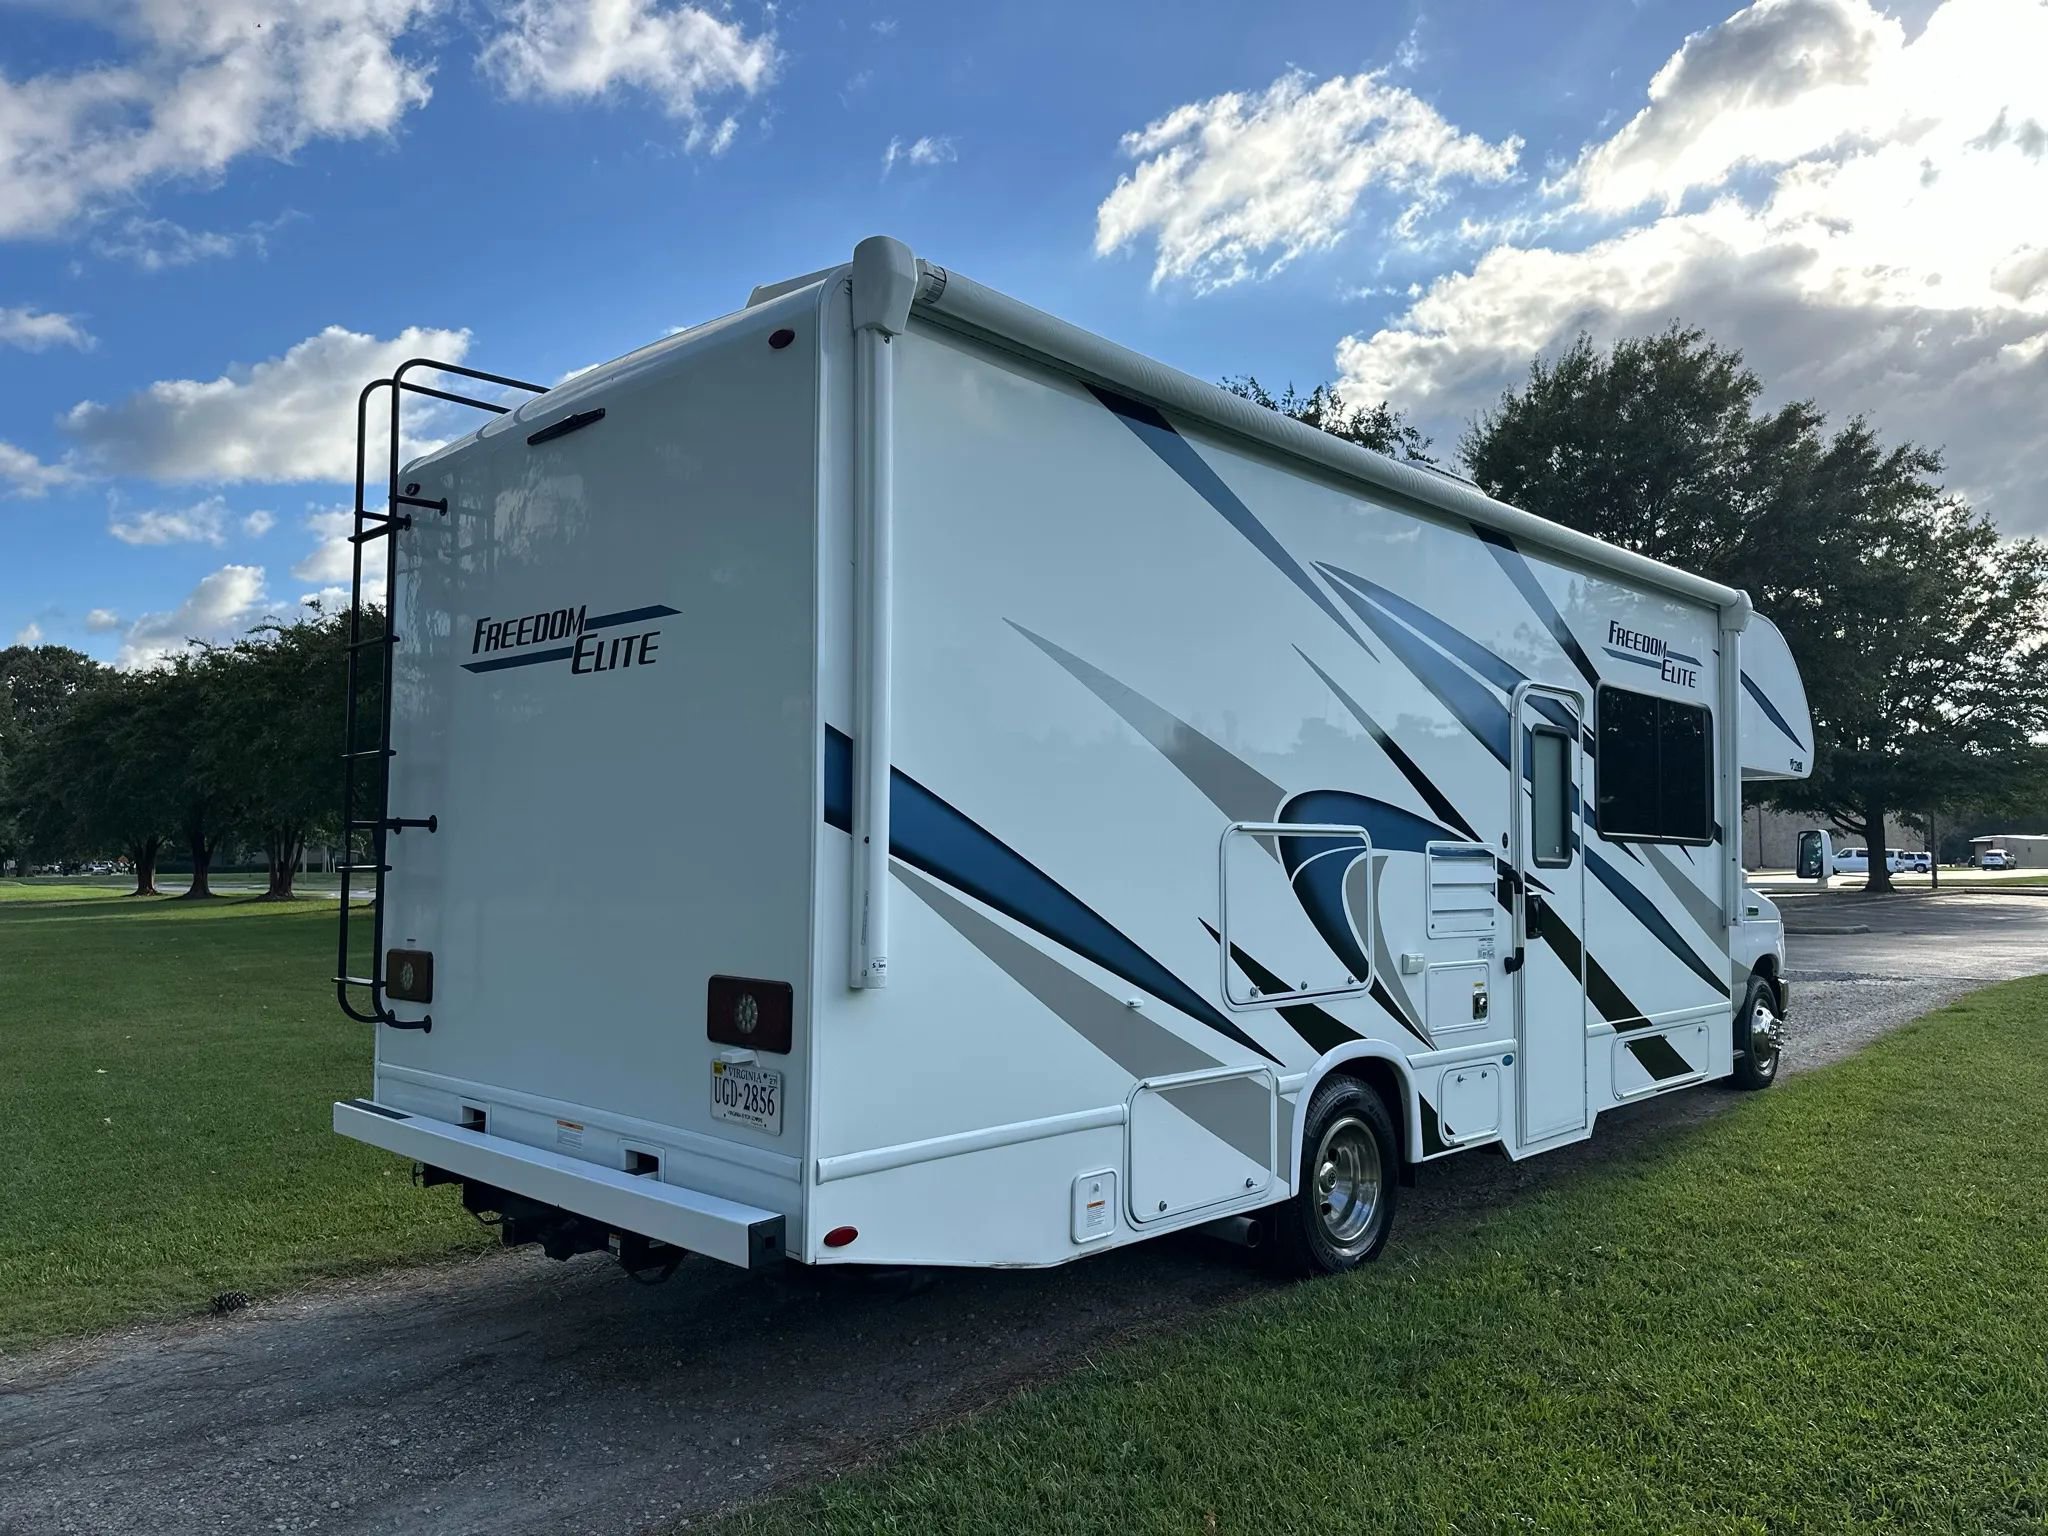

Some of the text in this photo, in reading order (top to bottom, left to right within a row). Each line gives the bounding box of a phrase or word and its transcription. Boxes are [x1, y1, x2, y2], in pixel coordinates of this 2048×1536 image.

[472, 604, 587, 655] FREEDOM
[1608, 619, 1667, 658] FREEDOM
[571, 630, 661, 675] ELITE
[1661, 658, 1697, 688] ELITE
[728, 1067, 762, 1084] VIRGINIA
